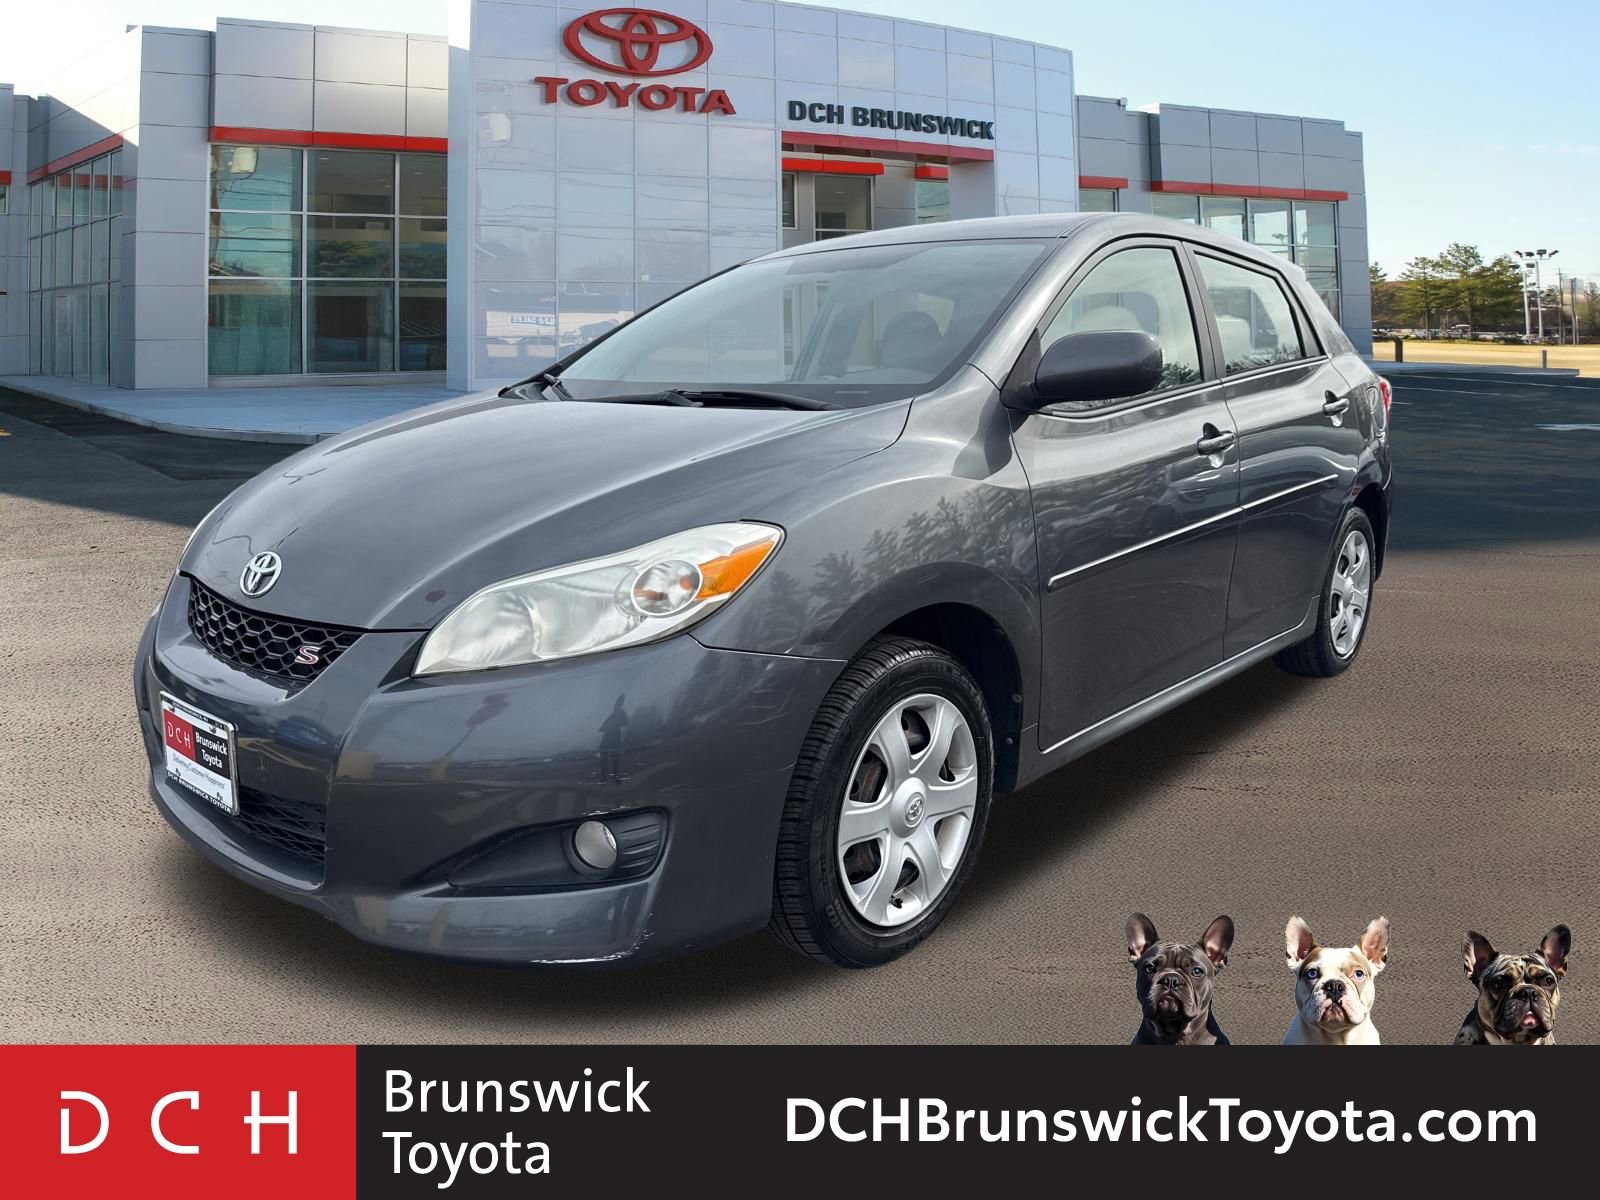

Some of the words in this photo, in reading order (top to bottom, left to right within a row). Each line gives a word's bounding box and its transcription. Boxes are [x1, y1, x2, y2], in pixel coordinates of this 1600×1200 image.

[534, 77, 736, 115] TOYOTA
[788, 100, 845, 126] DCH
[852, 105, 995, 141] BRUNSWICK
[294, 645, 322, 665] S
[167, 720, 191, 749] DCH
[195, 731, 228, 756] Brunswick
[201, 749, 223, 769] Toyota
[209, 796, 231, 813] TOYOTA
